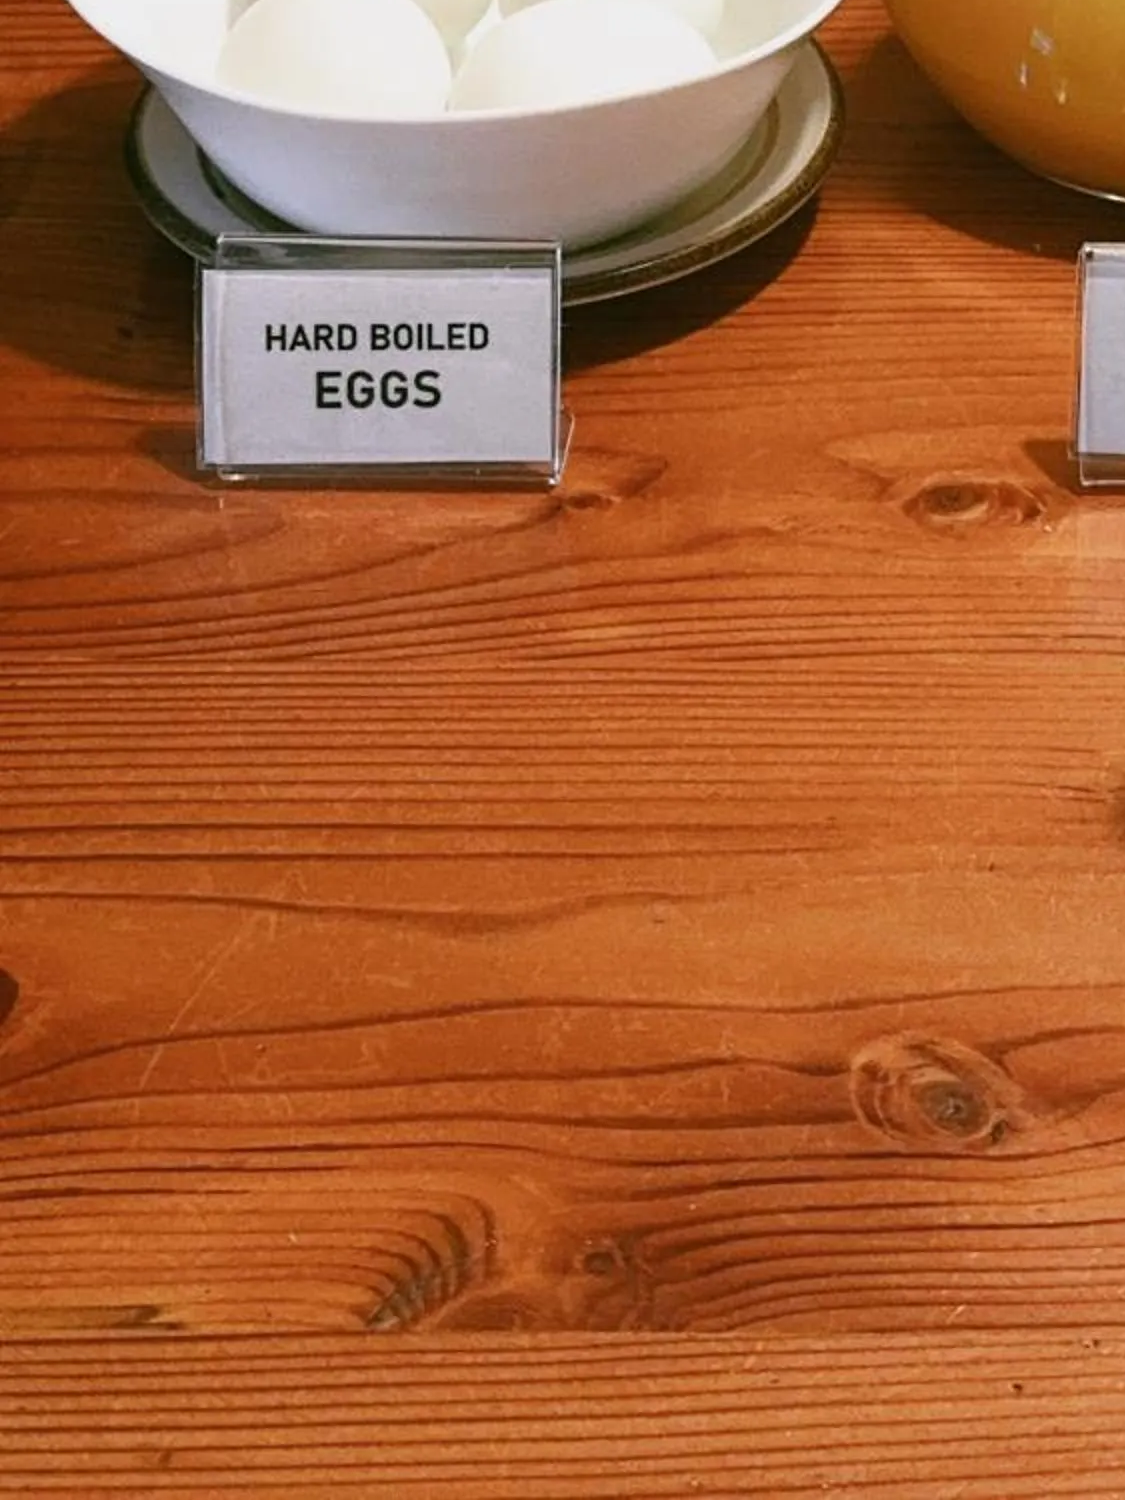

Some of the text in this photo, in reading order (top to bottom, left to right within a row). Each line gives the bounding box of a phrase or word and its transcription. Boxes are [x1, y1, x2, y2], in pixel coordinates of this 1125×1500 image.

[264, 322, 490, 352] HARD BOILED
[315, 369, 442, 409] EGGS
